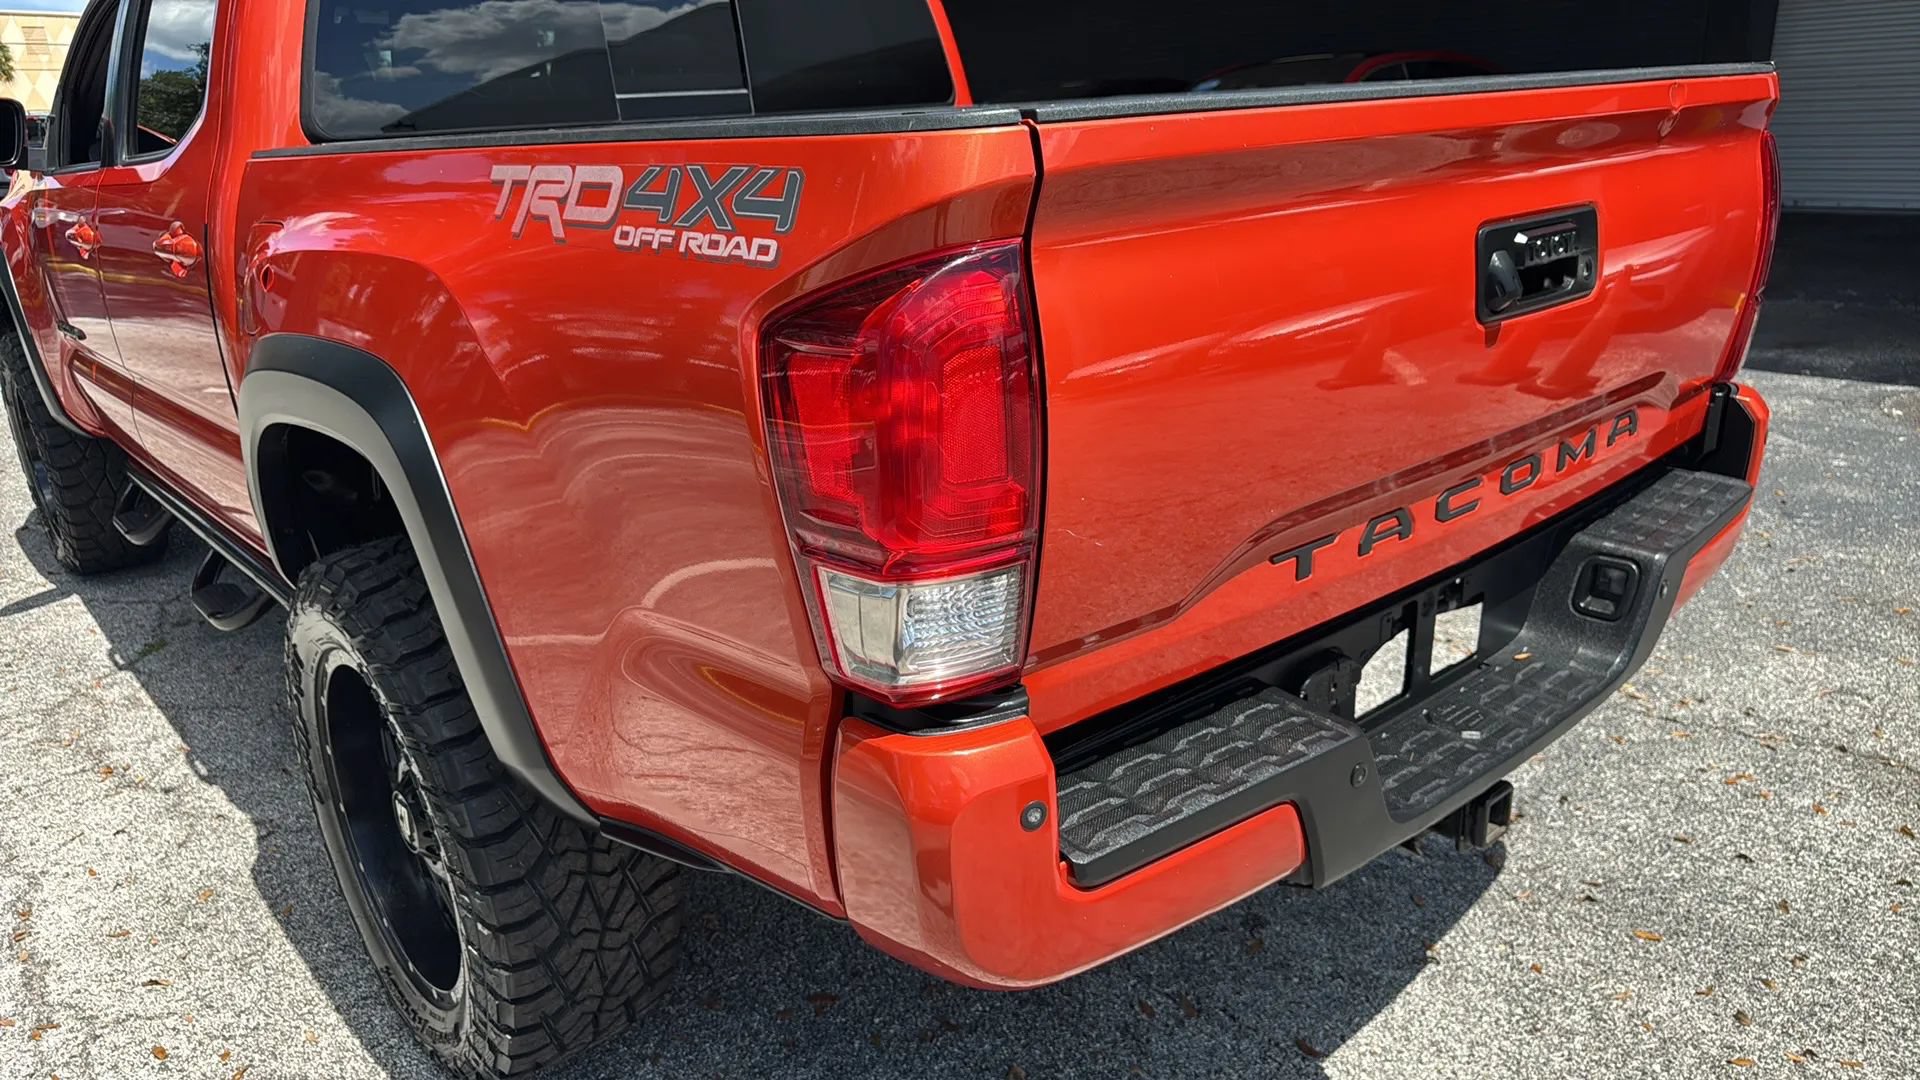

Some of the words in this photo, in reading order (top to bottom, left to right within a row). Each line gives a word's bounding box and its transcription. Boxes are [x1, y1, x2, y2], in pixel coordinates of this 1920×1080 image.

[490, 164, 625, 243] TRD
[612, 224, 676, 253] OFF
[678, 231, 781, 267] ROAD
[1268, 408, 1640, 583] TACOMA
